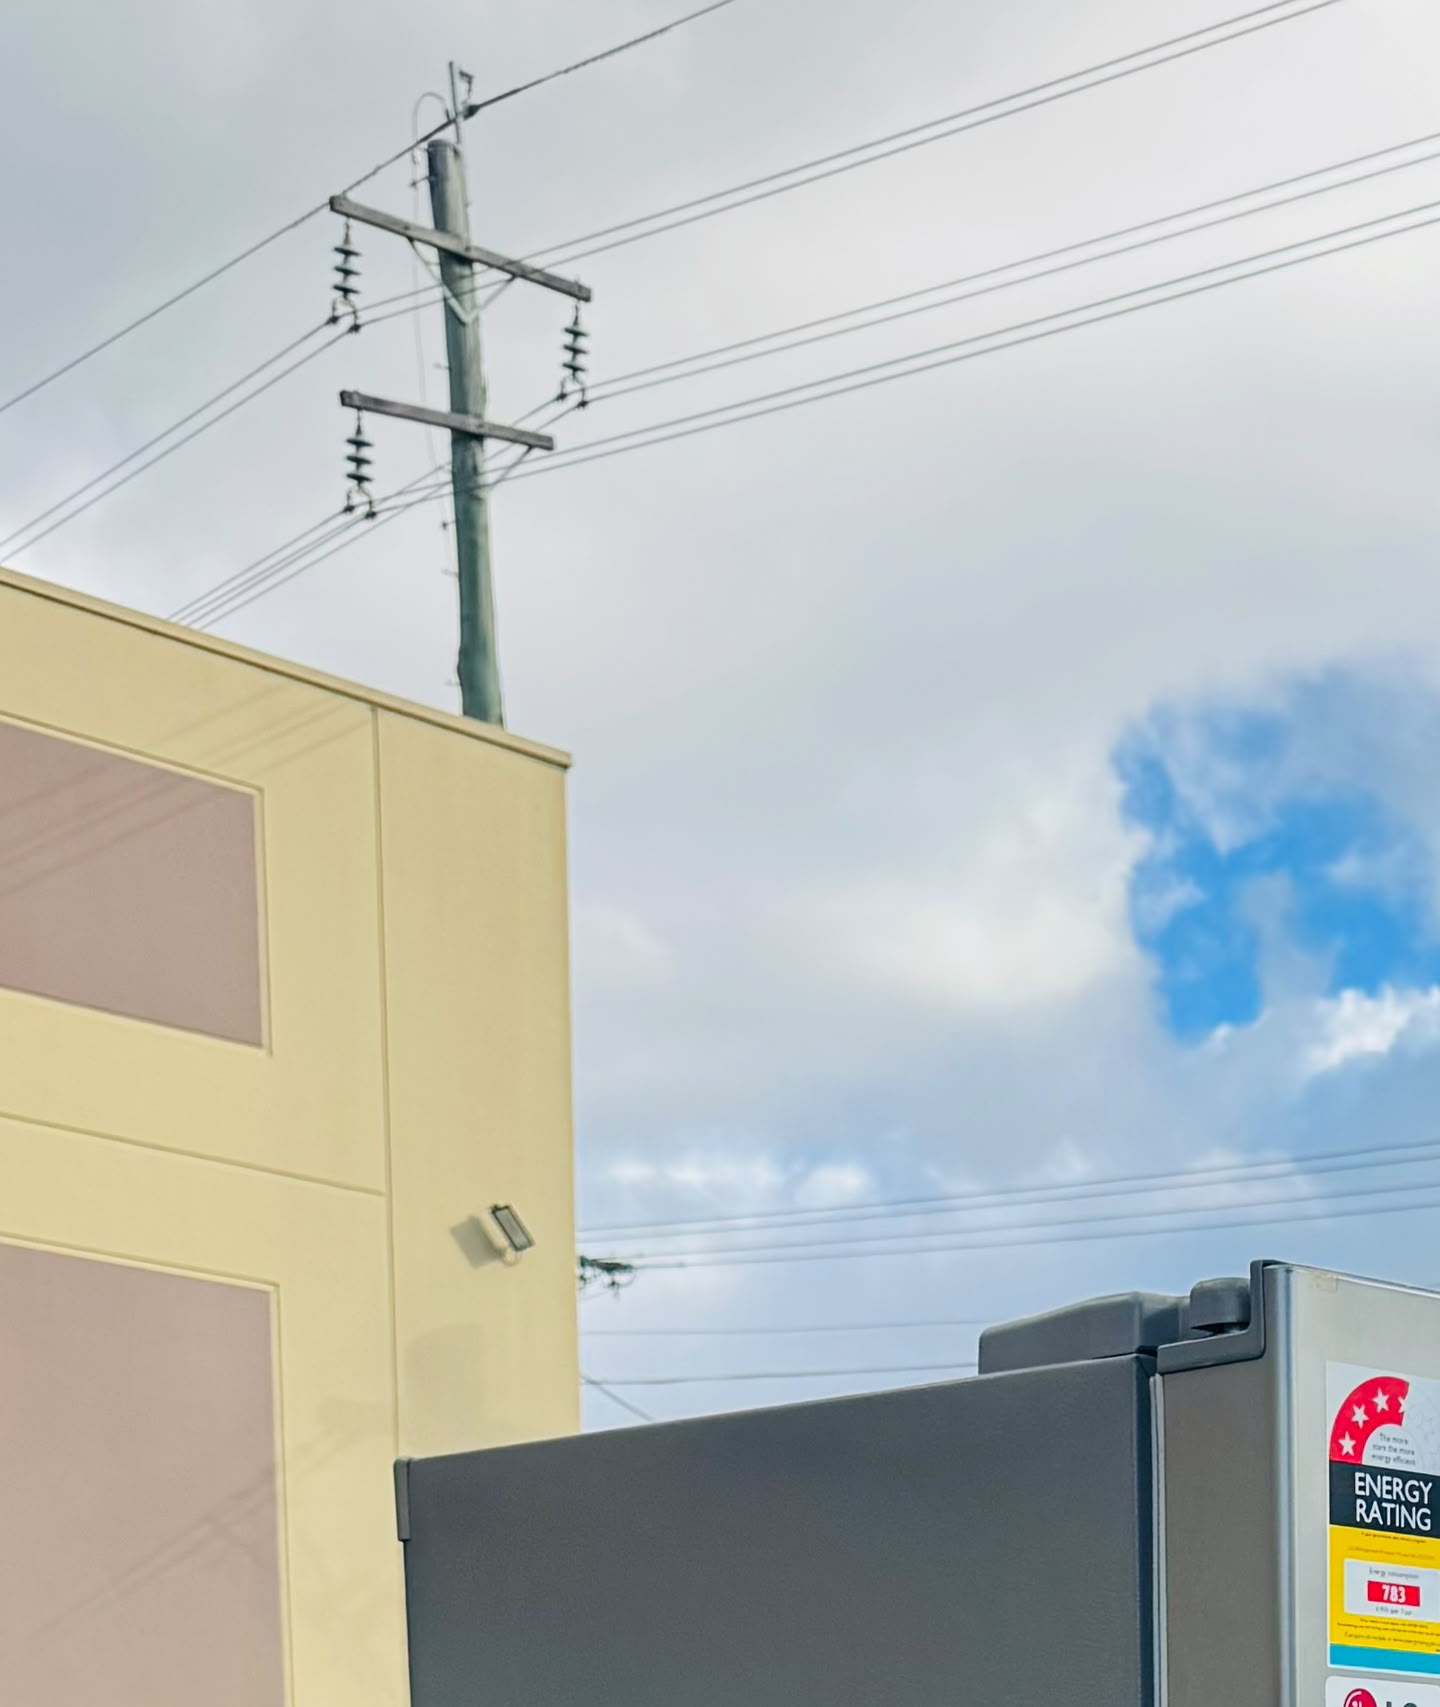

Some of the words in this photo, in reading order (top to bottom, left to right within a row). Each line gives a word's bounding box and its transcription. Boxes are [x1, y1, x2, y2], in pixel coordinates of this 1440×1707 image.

[1354, 1471, 1433, 1504] ENERGY
[1356, 1500, 1432, 1531] RATING
[1381, 1584, 1406, 1603] 783
